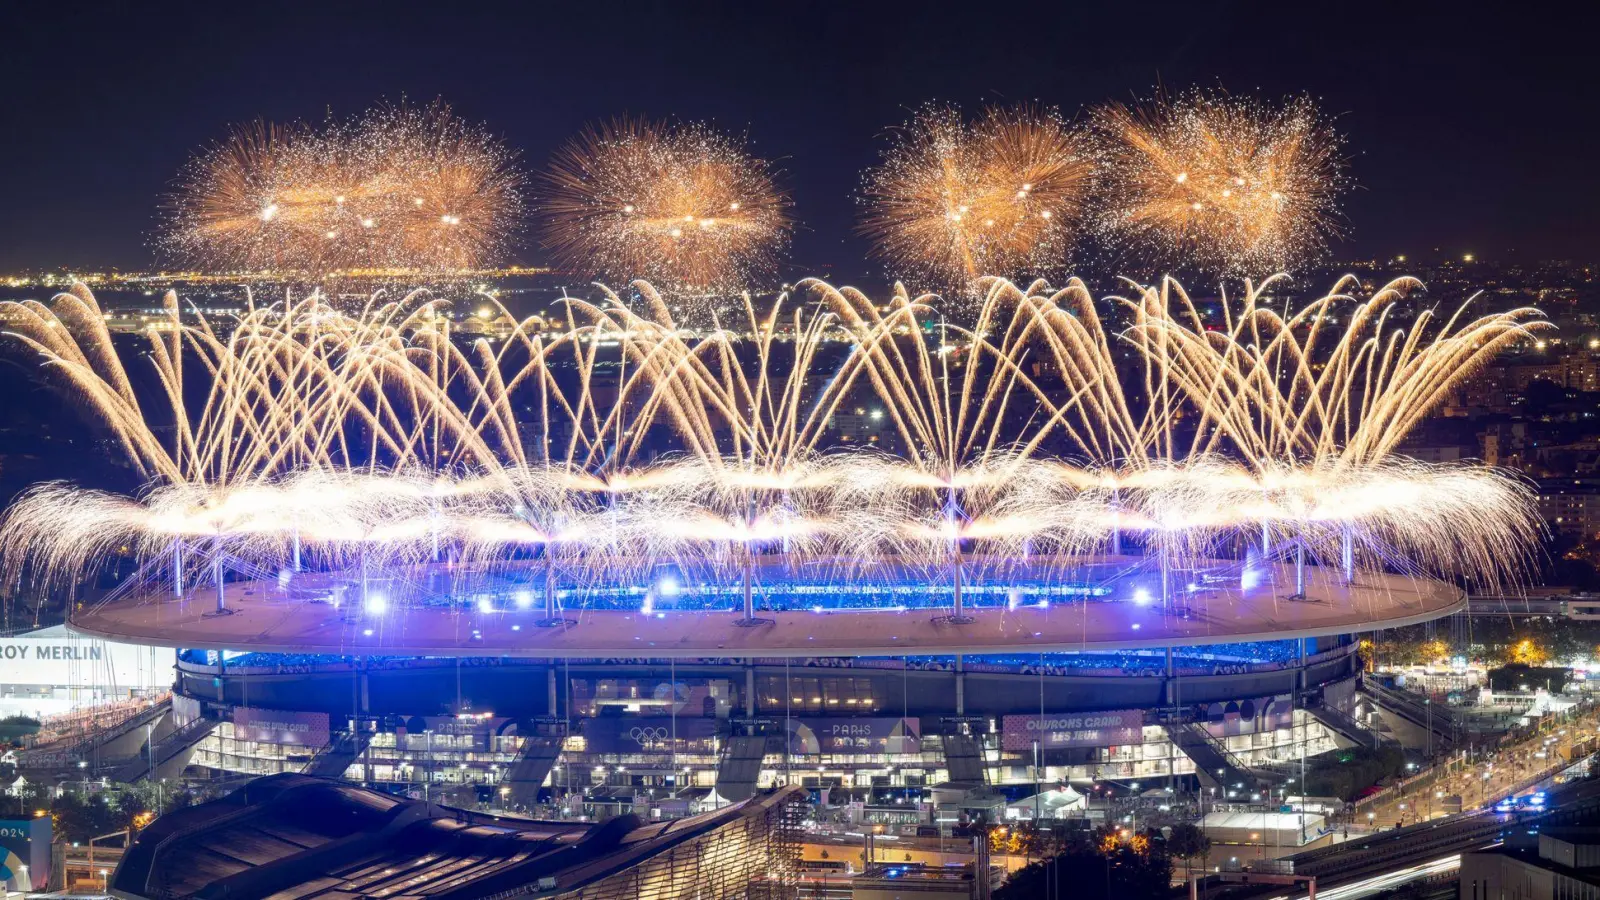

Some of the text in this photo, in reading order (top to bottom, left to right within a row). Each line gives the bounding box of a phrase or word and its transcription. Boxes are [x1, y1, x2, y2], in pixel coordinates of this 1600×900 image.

[36, 645, 101, 660] MERLIN
[289, 723, 309, 733] OPEN
[1026, 716, 1122, 730] OUVRONS GRAND
[832, 724, 872, 736] PARIS
[1052, 730, 1099, 742] LES JEUX
